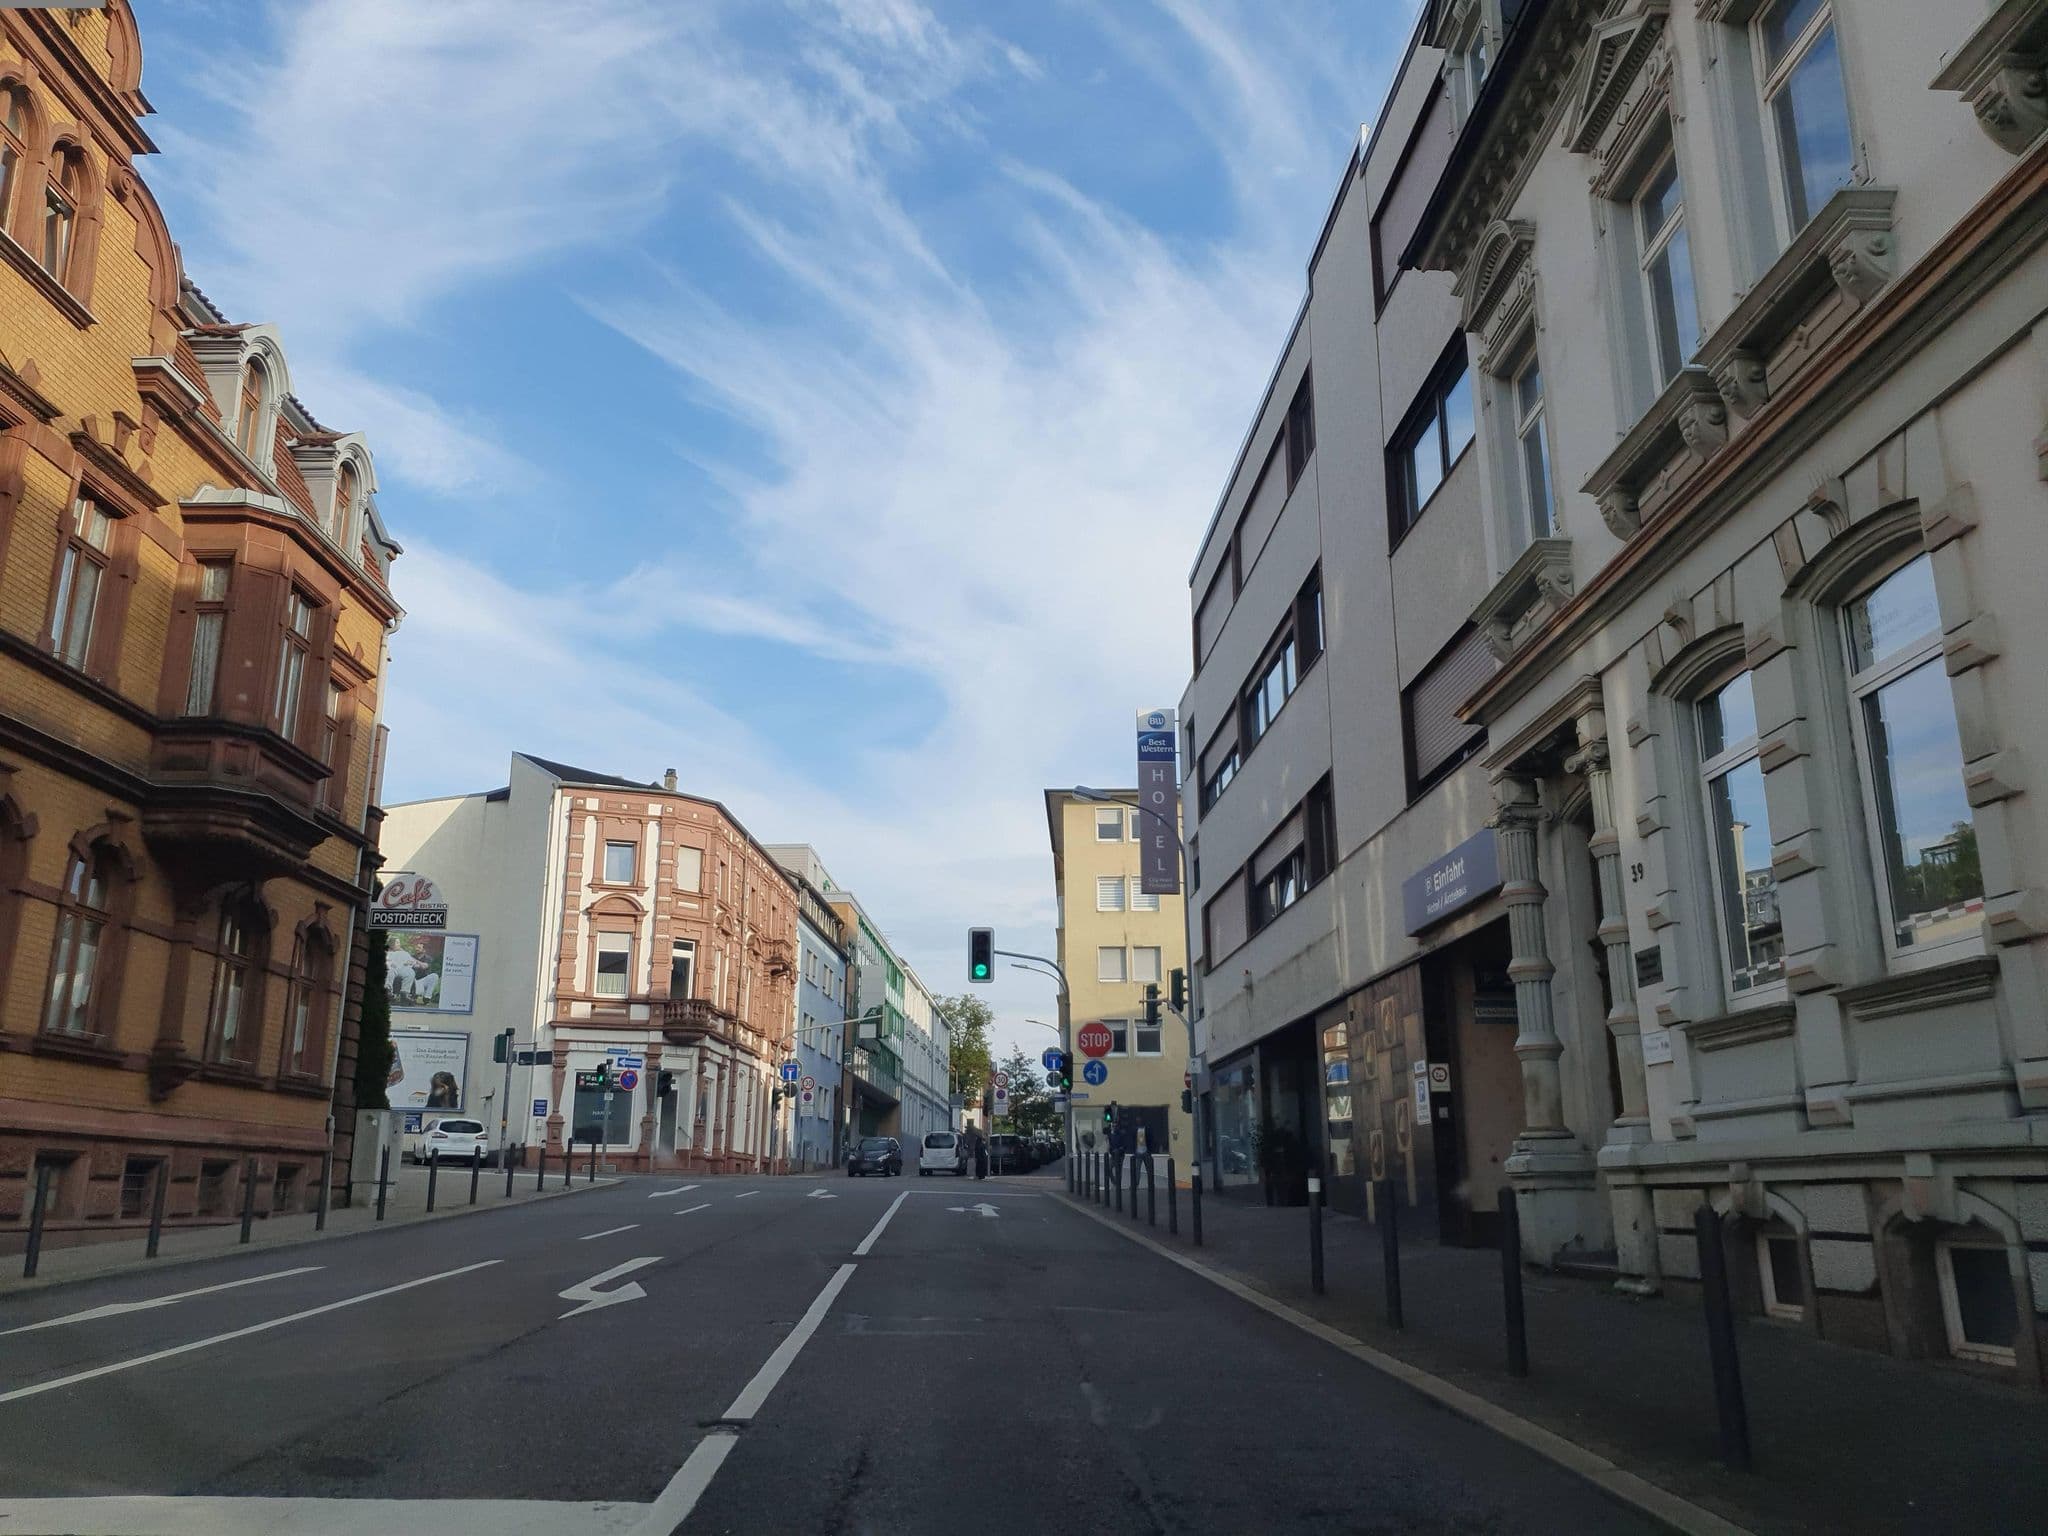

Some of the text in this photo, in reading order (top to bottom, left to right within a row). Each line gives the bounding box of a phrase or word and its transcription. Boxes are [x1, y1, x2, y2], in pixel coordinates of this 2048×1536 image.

[1149, 717, 1164, 725] BW
[1141, 745, 1173, 753] Western
[1148, 738, 1166, 746] Best
[1152, 769, 1167, 871] HOTEL
[1433, 857, 1465, 892] Einfahrt
[1631, 862, 1644, 883] 39
[383, 878, 432, 909] Café
[372, 912, 444, 925] POSTDREIECK
[1080, 1032, 1110, 1048] STOP
